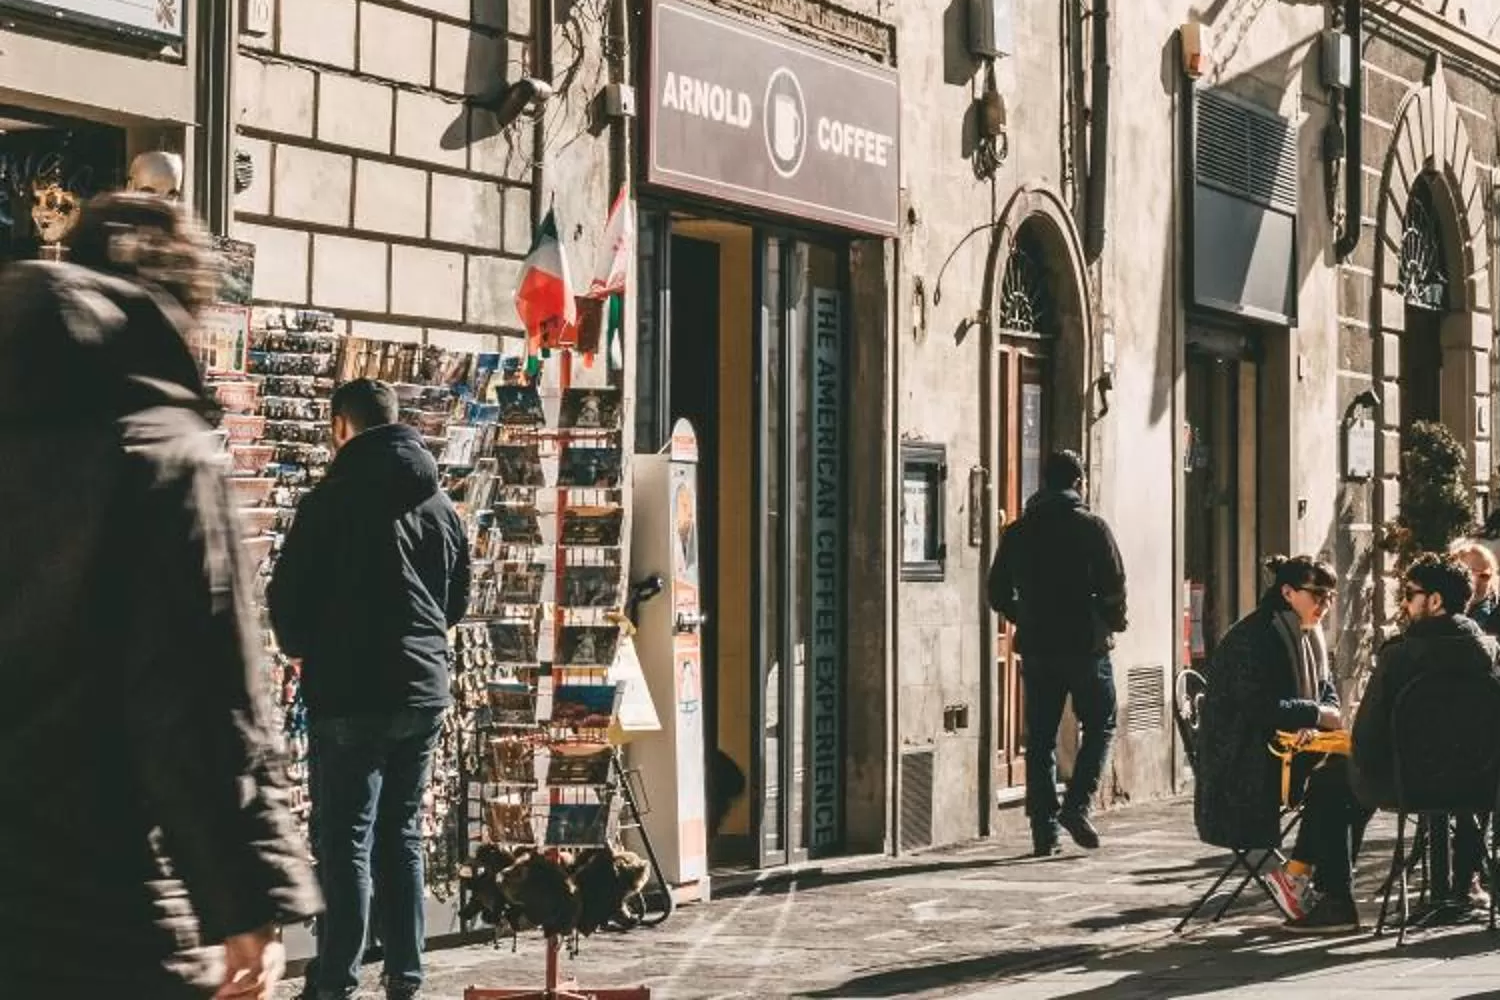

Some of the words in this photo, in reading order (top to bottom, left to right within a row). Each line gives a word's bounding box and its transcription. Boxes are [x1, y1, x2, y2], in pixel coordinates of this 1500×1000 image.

[662, 71, 753, 129] ARNOLD
[817, 116, 889, 168] COFFEE
[816, 296, 837, 349] THE
[816, 356, 837, 519] AMERICAN
[815, 528, 837, 646] COFFEE
[815, 655, 836, 846] EXPERIENCE
